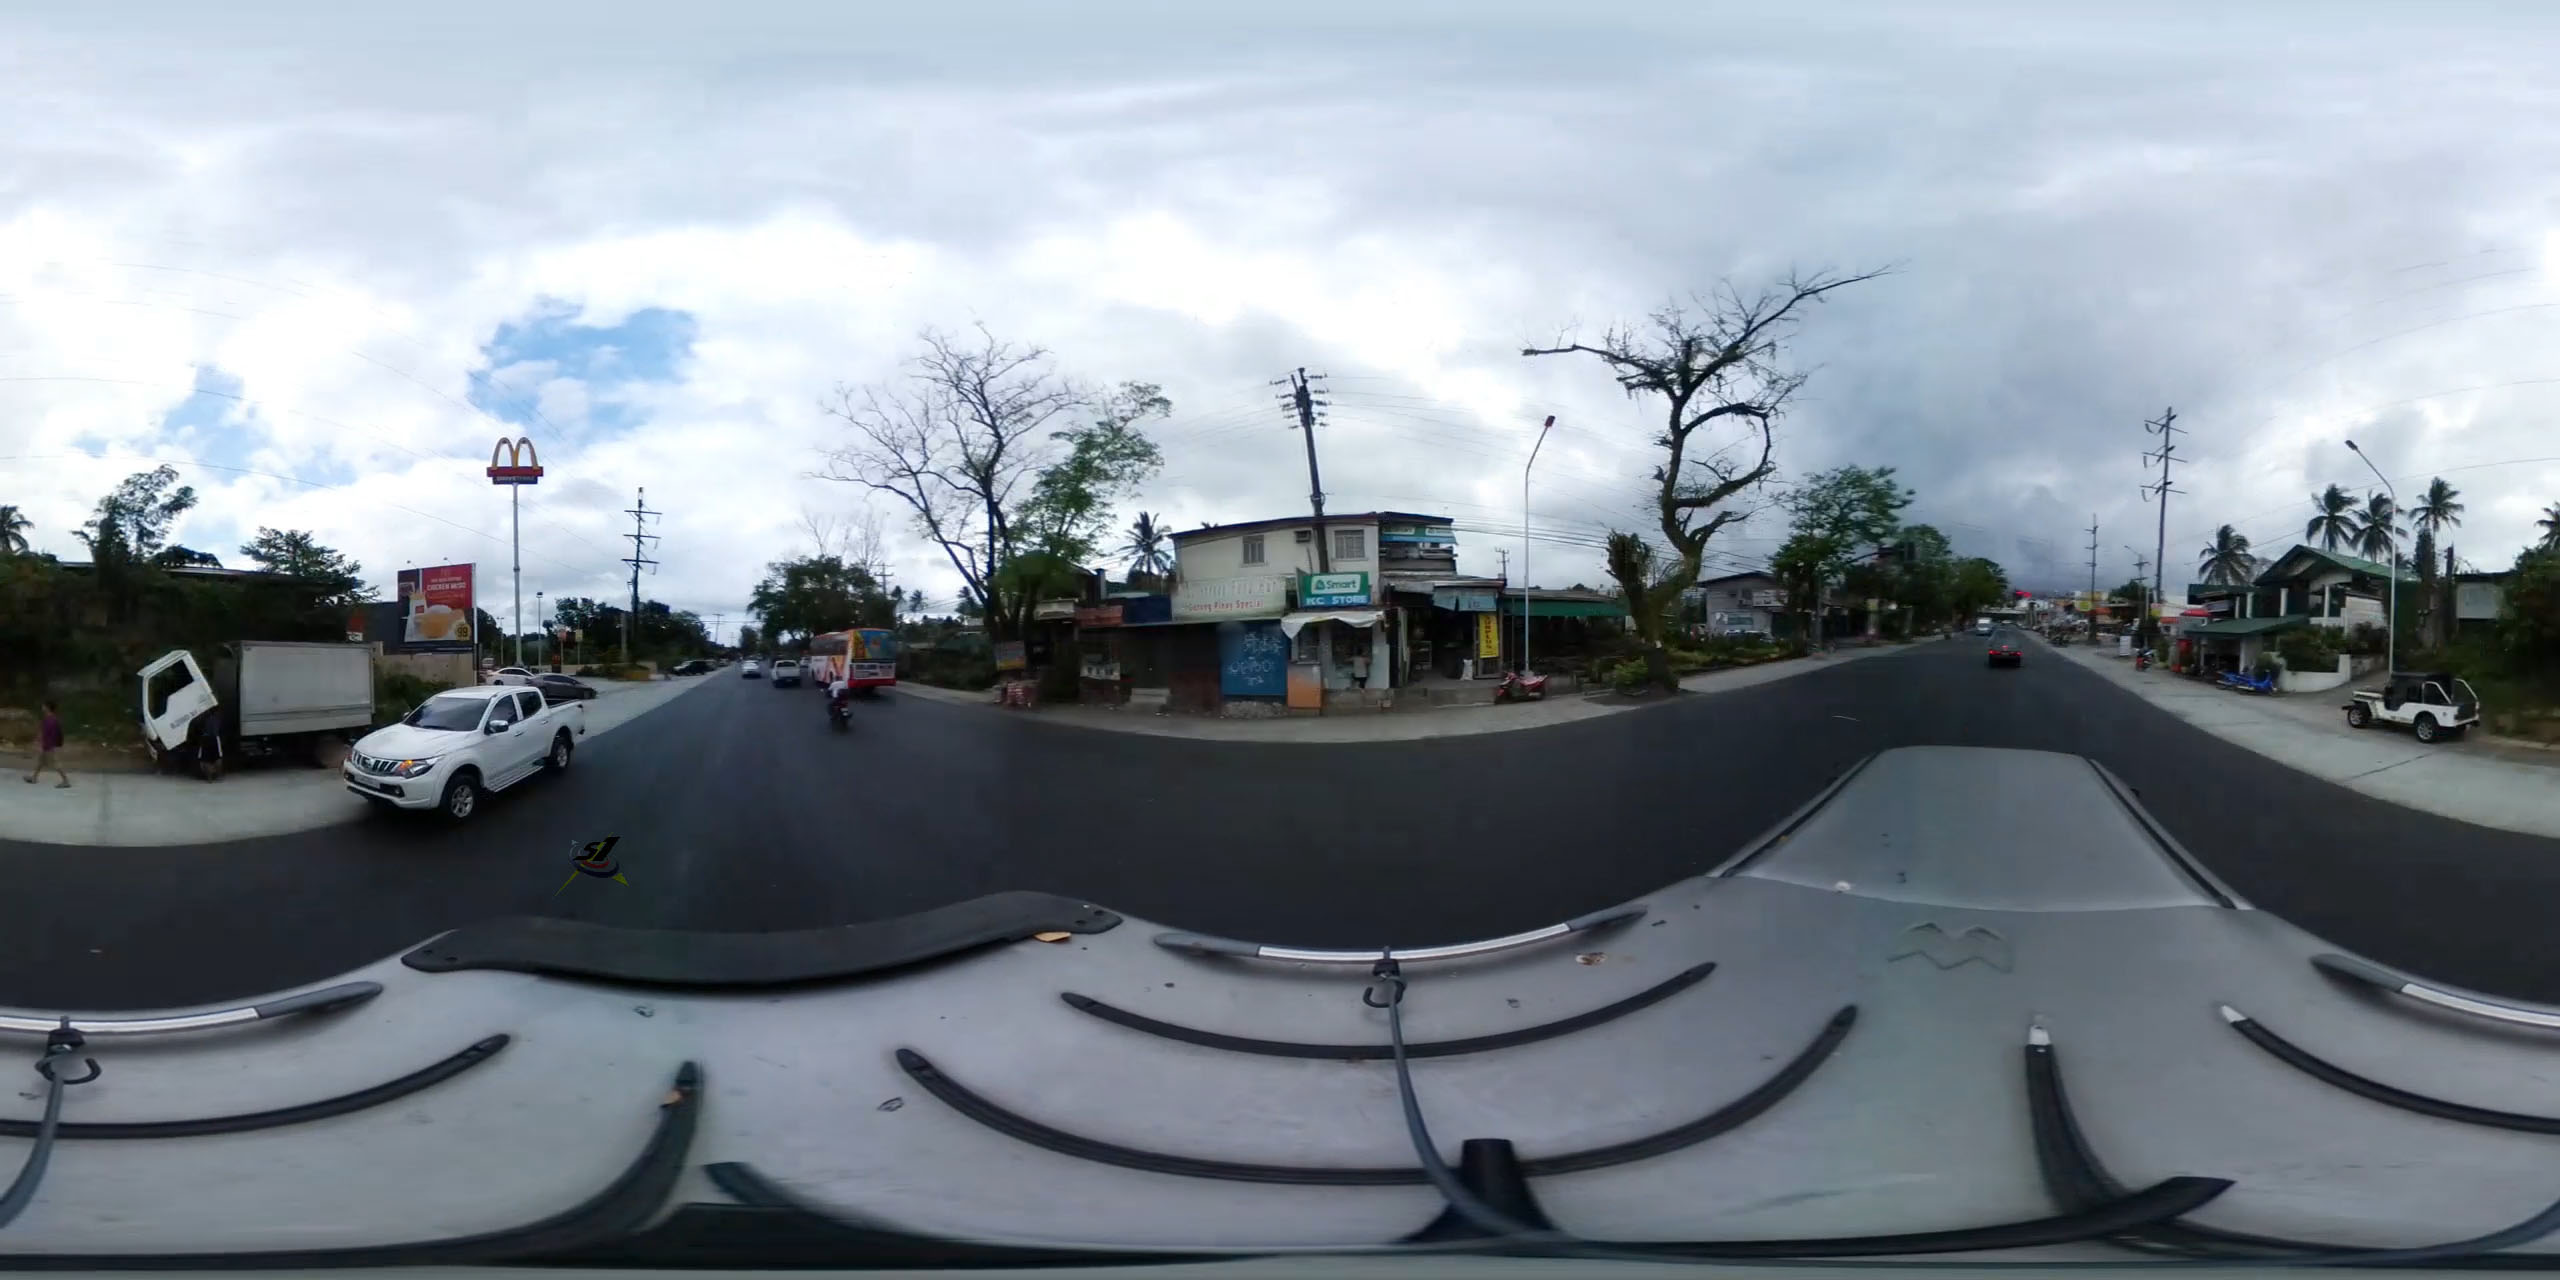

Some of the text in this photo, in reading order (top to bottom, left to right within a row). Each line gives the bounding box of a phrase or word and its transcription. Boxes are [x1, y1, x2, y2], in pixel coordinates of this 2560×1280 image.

[1326, 579, 1357, 589] Smart
[1331, 595, 1368, 604] STORE
[456, 626, 469, 637] 99
